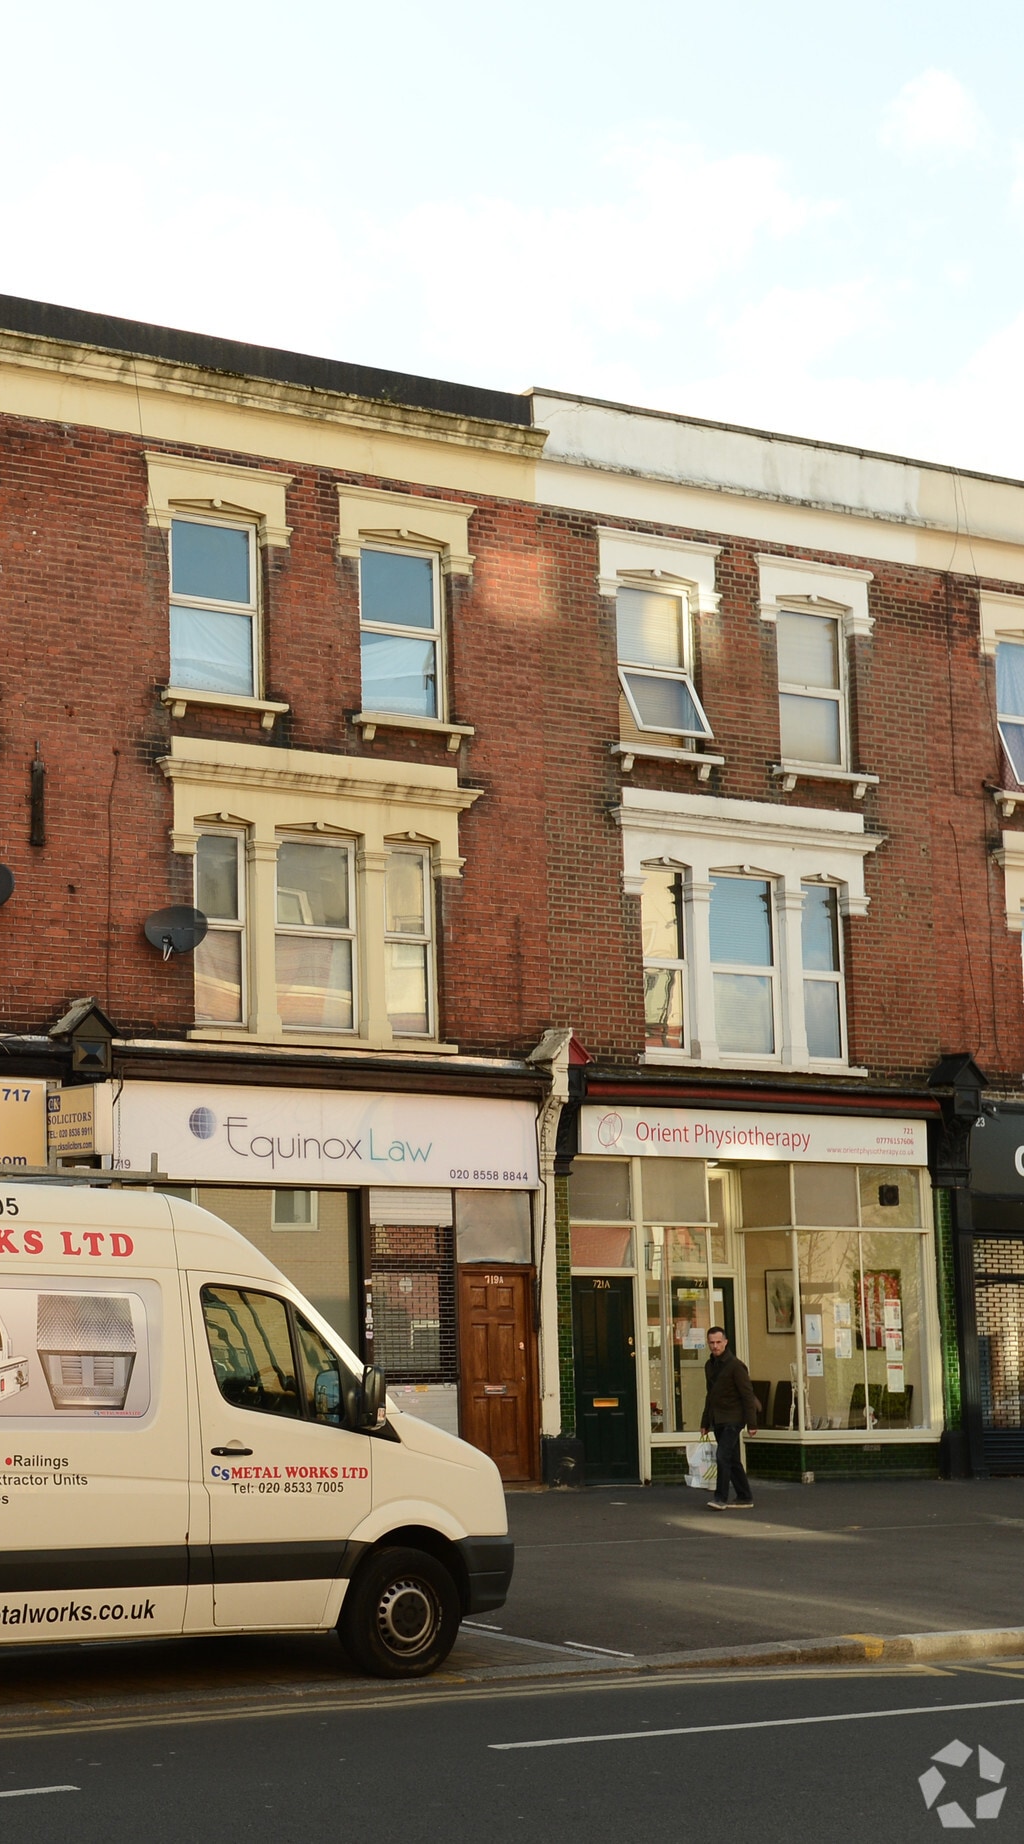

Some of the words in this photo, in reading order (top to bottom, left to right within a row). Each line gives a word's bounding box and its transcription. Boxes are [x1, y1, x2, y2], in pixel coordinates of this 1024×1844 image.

[2, 1088, 31, 1102] 717
[47, 1111, 92, 1126] SOLICITORS
[975, 1117, 985, 1128] 23
[59, 1129, 68, 1138] 020
[636, 1121, 689, 1143] Orient
[694, 1123, 811, 1152] Physiotherapy
[902, 1127, 914, 1135] 721
[223, 1116, 362, 1169] Equinox
[370, 1128, 433, 1162] Law
[114, 1159, 131, 1169] 719
[449, 1169, 470, 1179] 020
[473, 1170, 499, 1180] 8558
[502, 1171, 528, 1181] 8844
[59, 1231, 135, 1258] LTD
[484, 1275, 504, 1284] 719A
[592, 1280, 611, 1289] 721A
[13, 1454, 69, 1469] Railings
[53, 1473, 88, 1486] Units
[211, 1465, 230, 1481] CS
[231, 1466, 282, 1479] METAL
[285, 1466, 338, 1479] WORKS
[342, 1466, 369, 1479] LTD
[232, 1482, 254, 1494] Tel:
[258, 1482, 280, 1494] 020
[283, 1482, 313, 1493] 8533
[316, 1481, 344, 1493] 7005
